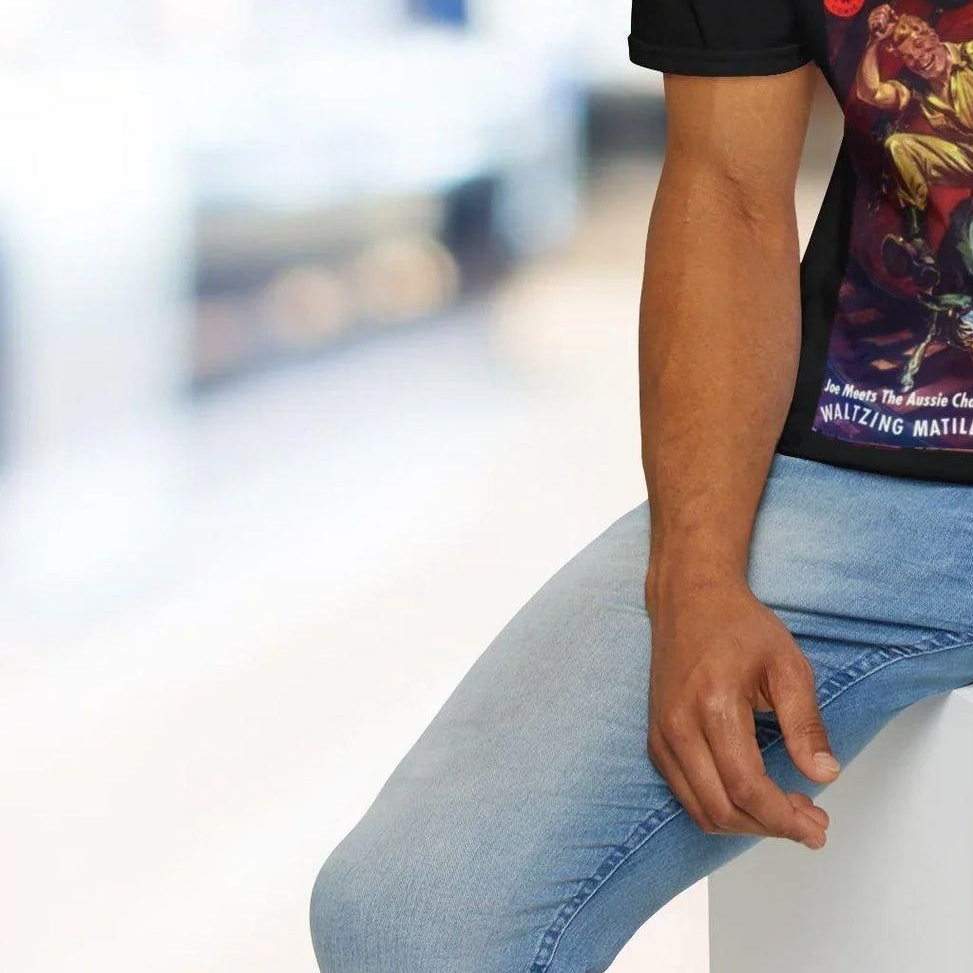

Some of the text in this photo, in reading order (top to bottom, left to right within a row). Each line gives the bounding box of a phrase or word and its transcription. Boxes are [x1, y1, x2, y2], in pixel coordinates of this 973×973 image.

[824, 378, 840, 395] Joe
[842, 383, 878, 403] Meets
[881, 389, 903, 406] The
[905, 391, 949, 408] Aussie
[820, 402, 905, 436] WALTZING
